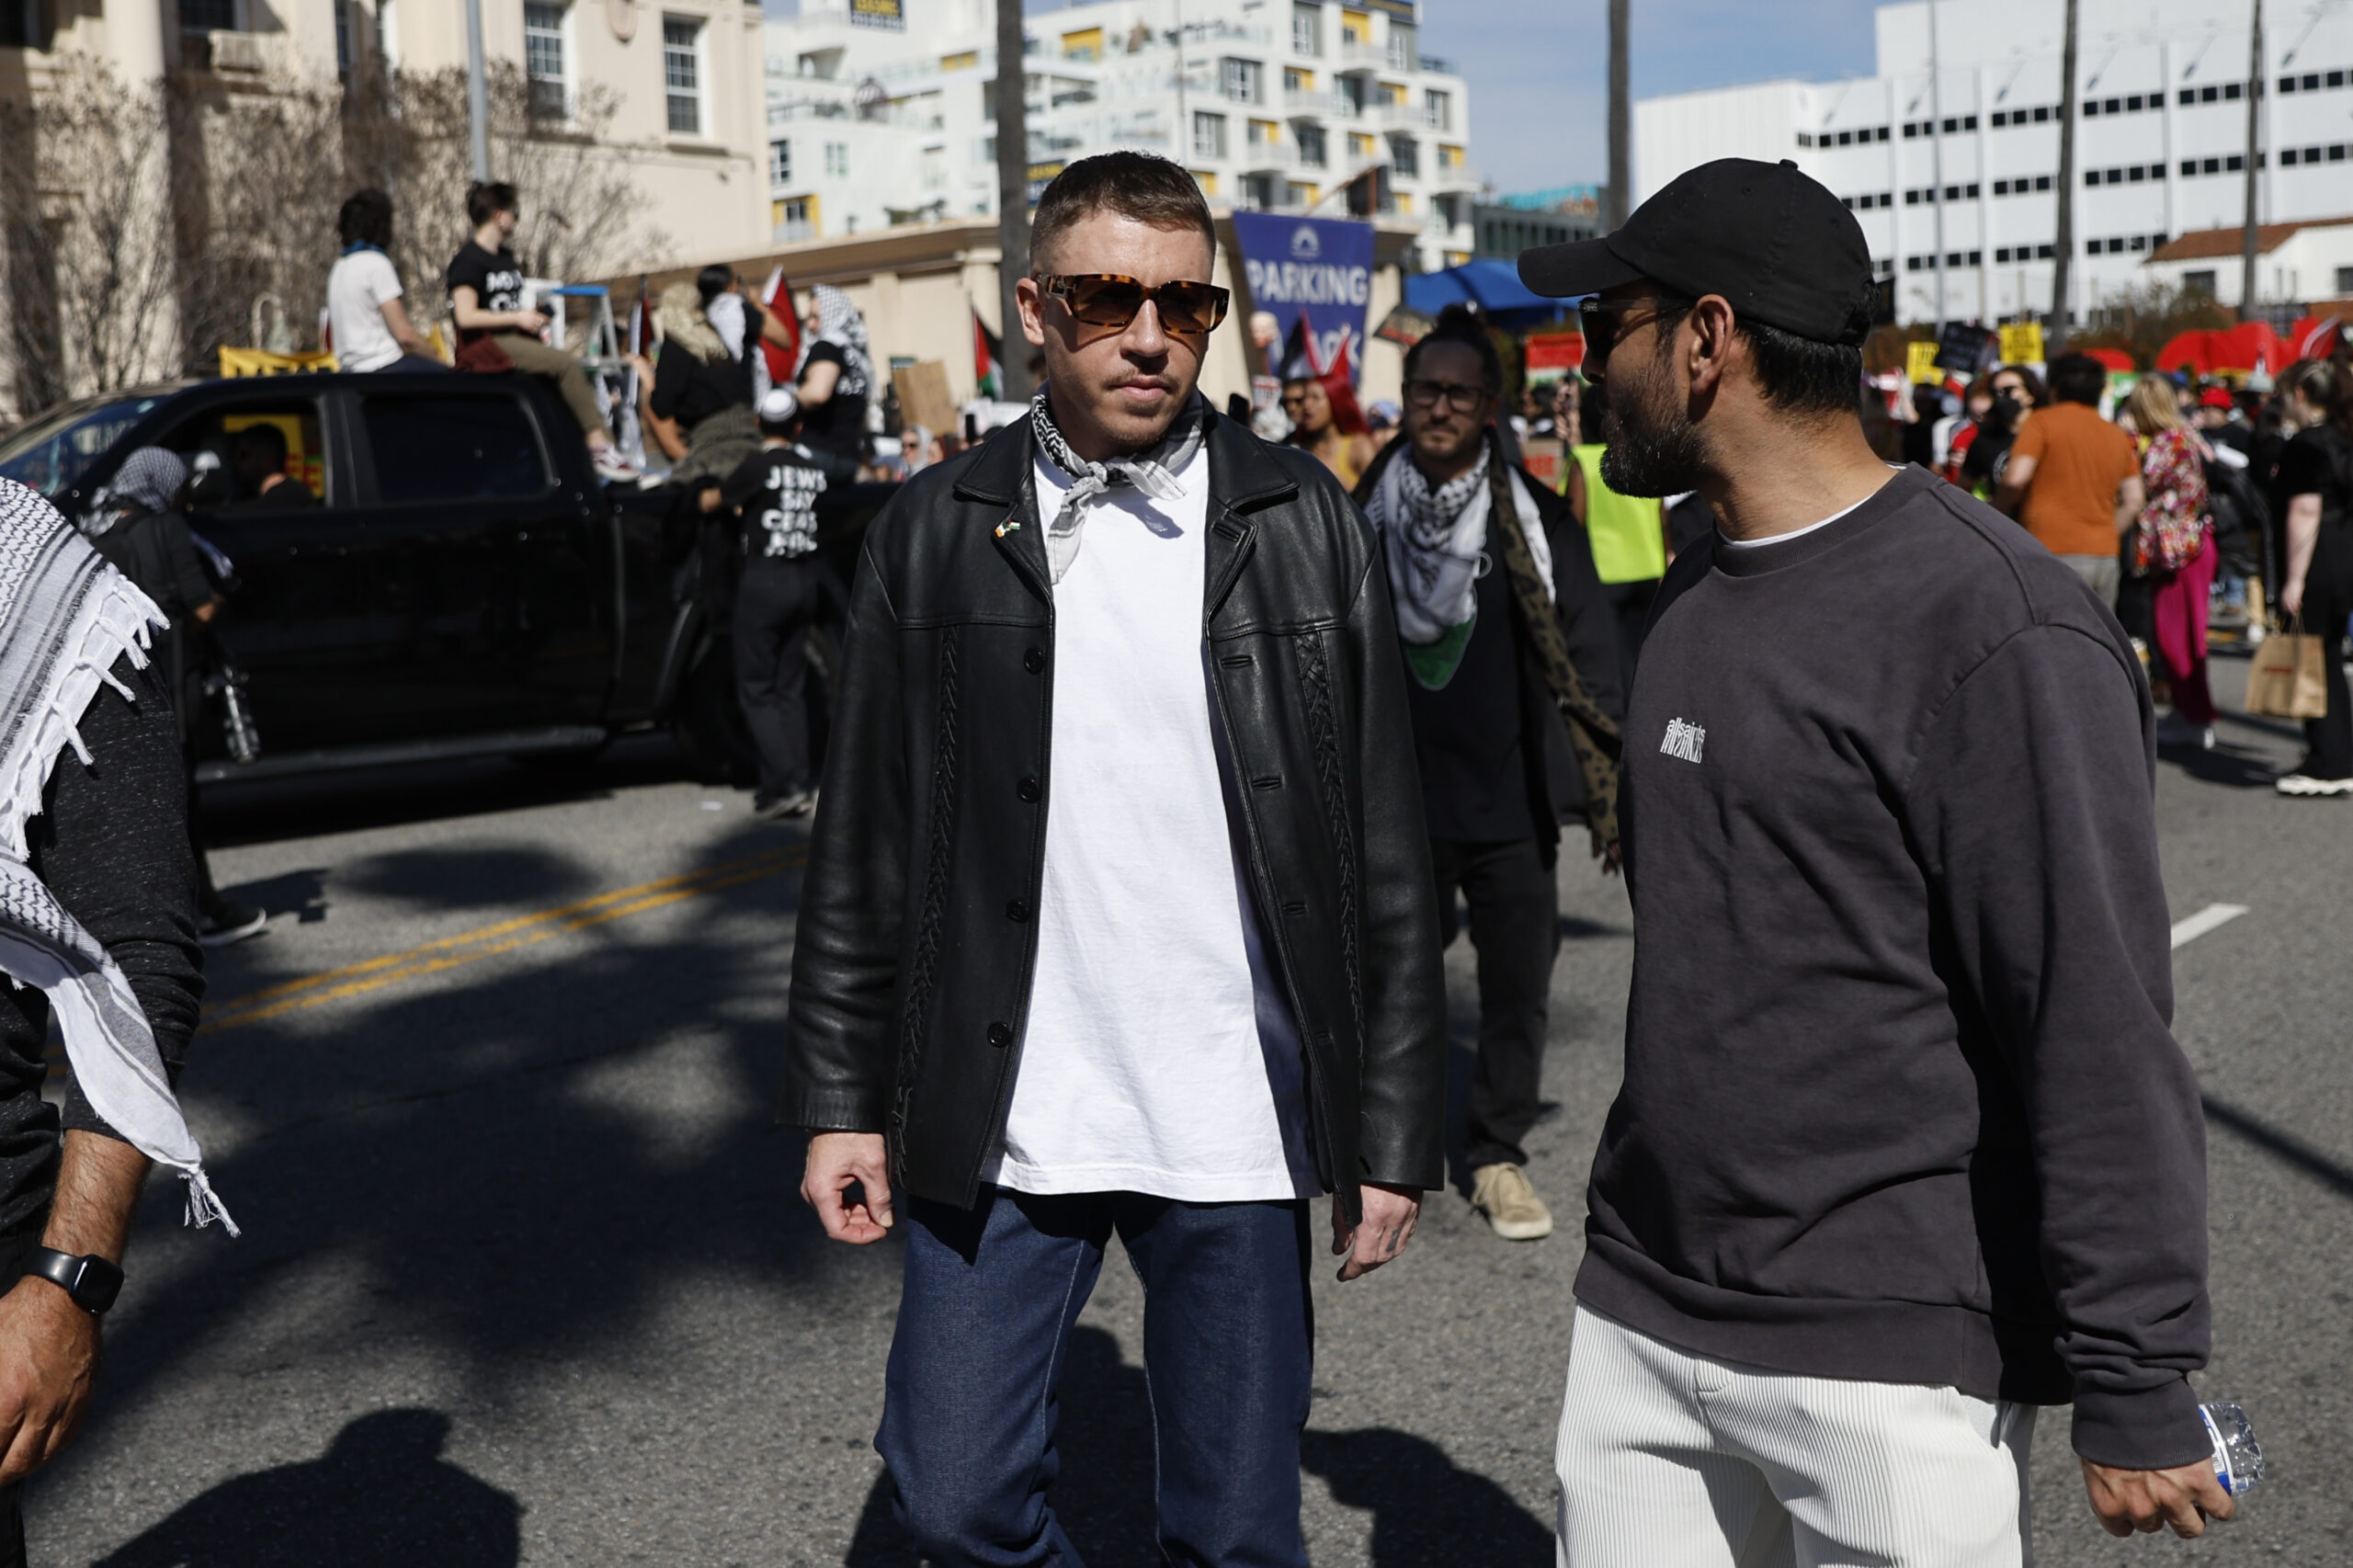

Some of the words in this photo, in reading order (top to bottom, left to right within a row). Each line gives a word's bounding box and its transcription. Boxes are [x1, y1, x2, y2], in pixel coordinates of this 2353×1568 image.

[1245, 258, 1368, 306] PARKING
[765, 464, 827, 494] JEWS
[780, 489, 817, 511] SAY
